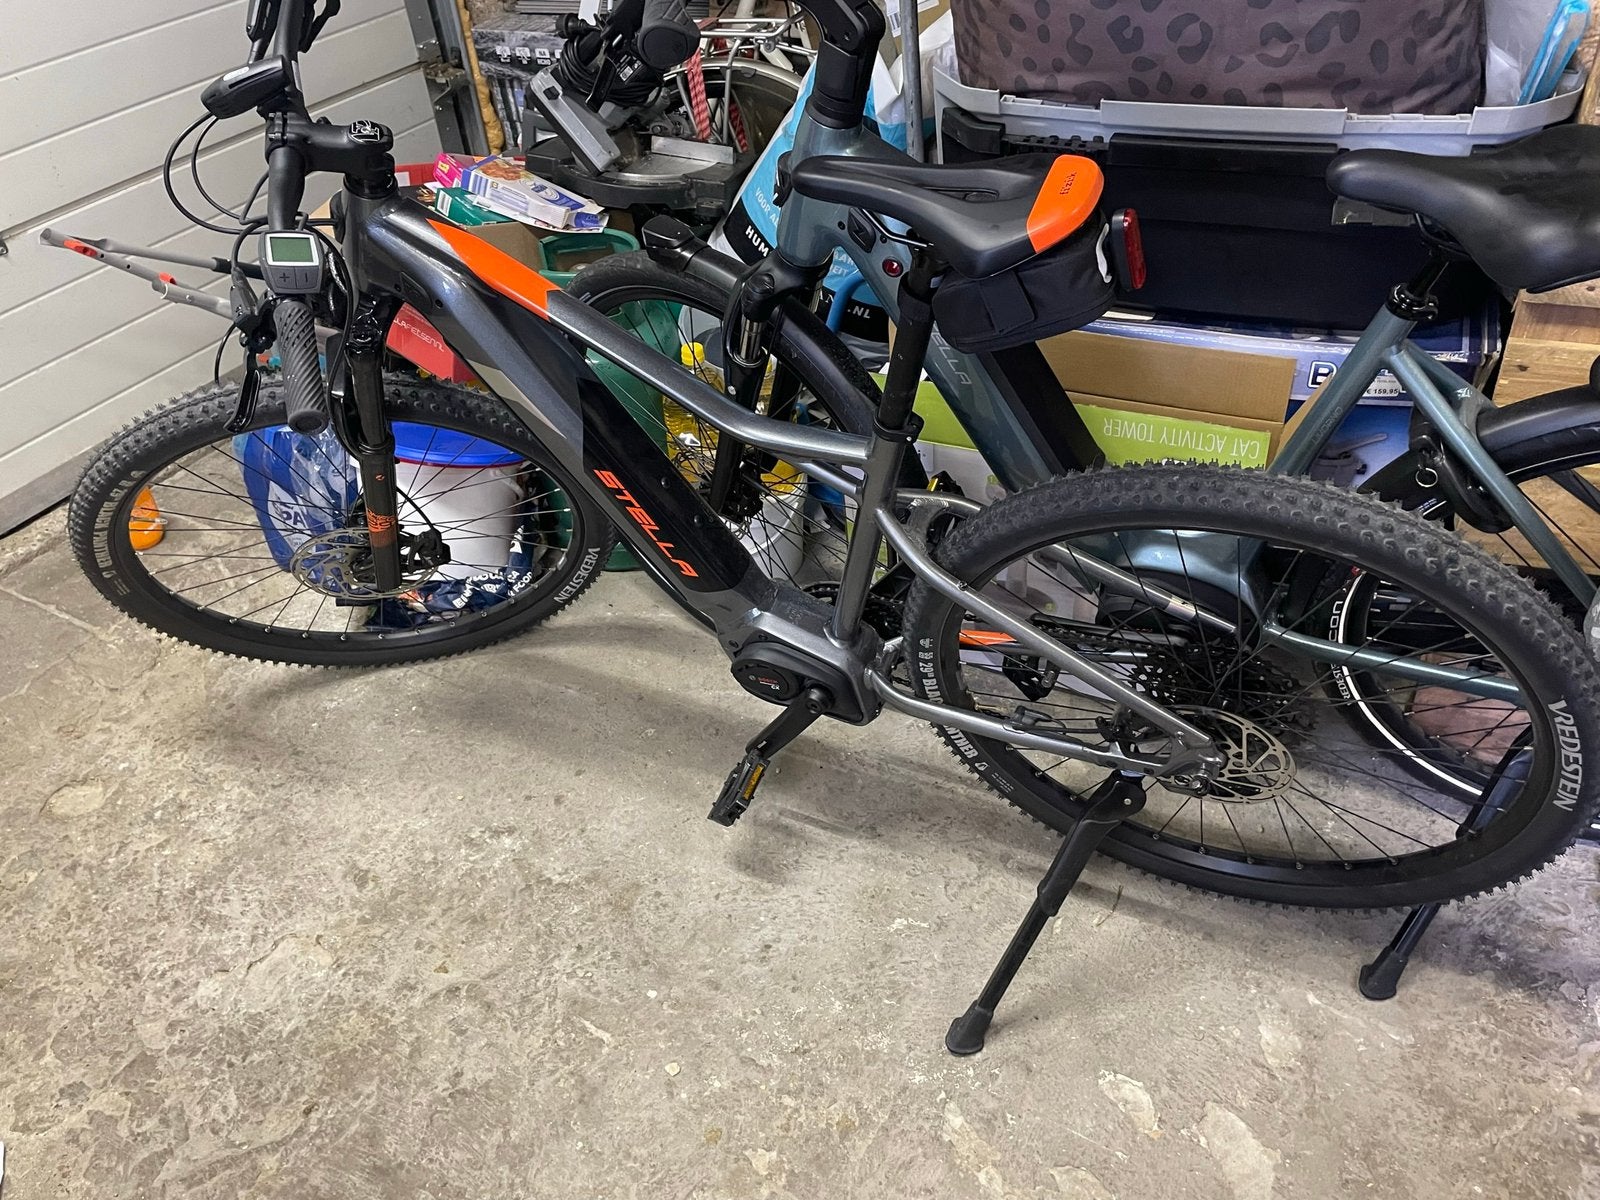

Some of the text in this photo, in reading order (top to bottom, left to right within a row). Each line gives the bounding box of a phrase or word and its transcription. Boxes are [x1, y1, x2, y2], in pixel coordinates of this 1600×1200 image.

[755, 187, 770, 216] VOOR
[1103, 417, 1260, 460] CAT ACTIVITY TOWER
[593, 469, 699, 578] STELLA
[553, 547, 601, 604] VREDESTEIN
[922, 677, 944, 704] BLAC
[942, 724, 979, 759] NTHER
[1547, 699, 1583, 812] VREDESTEIN
